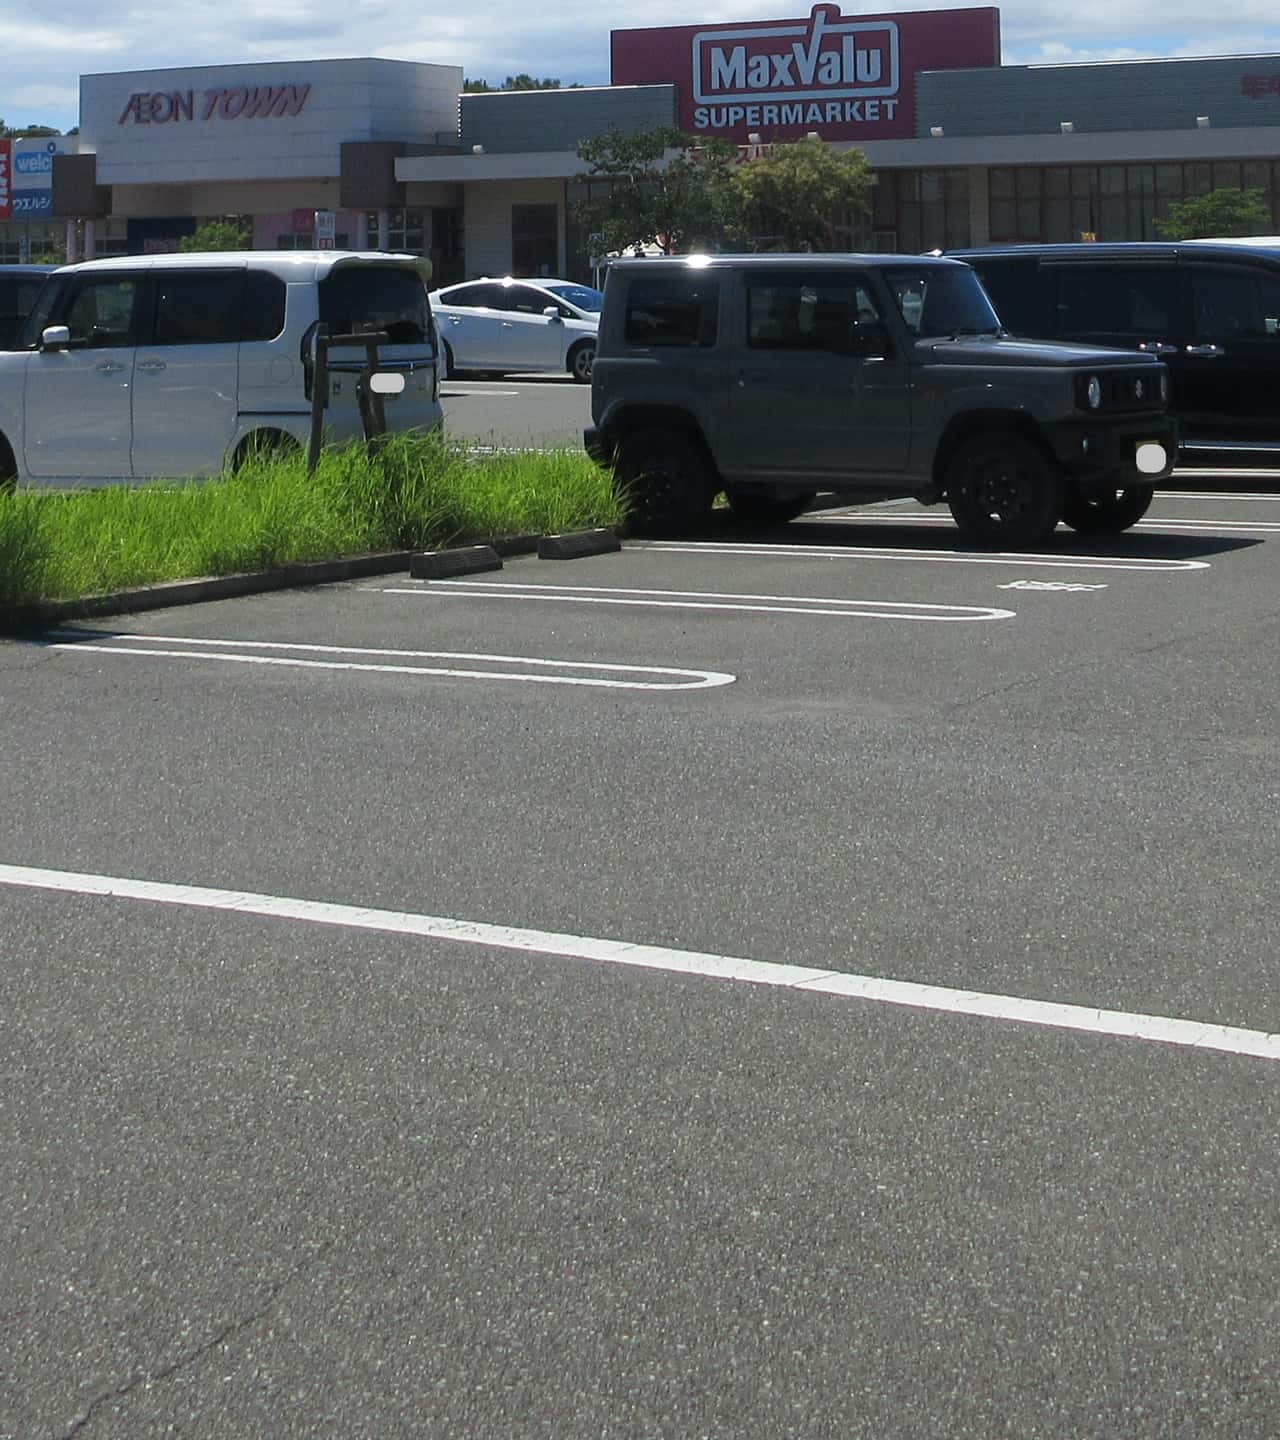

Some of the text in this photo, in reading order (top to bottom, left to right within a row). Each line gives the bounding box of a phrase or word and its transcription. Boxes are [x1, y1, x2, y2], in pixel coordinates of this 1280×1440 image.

[711, 10, 882, 90] MaxValu
[202, 84, 312, 120] TOWN
[694, 99, 899, 129] SUPERMARKET
